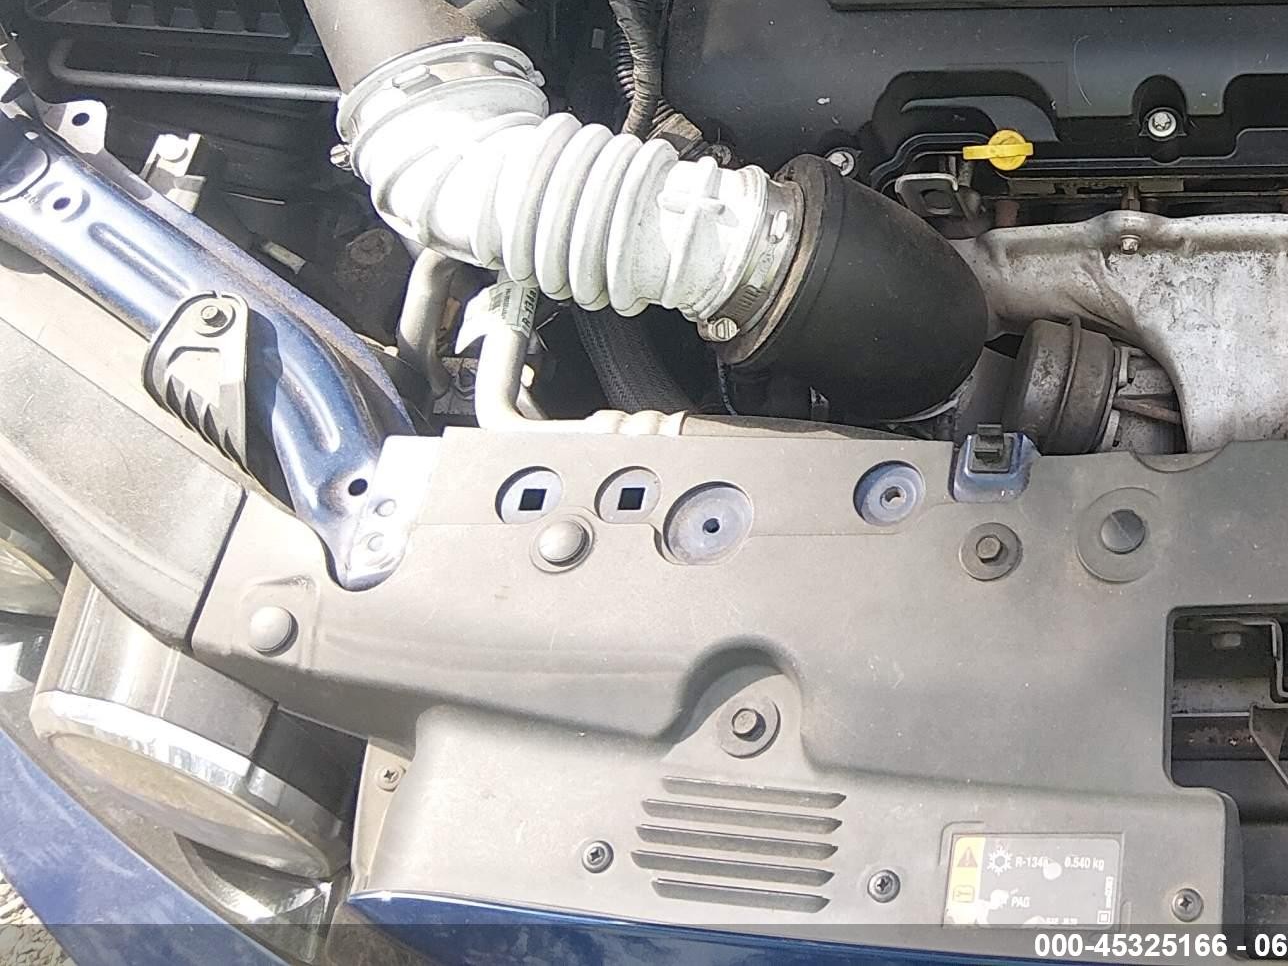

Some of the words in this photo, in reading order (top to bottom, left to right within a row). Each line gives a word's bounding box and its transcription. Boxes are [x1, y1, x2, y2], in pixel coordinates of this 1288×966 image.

[1064, 856, 1091, 869] 0.540
[1092, 857, 1105, 872] kg
[1011, 896, 1031, 908] PAG
